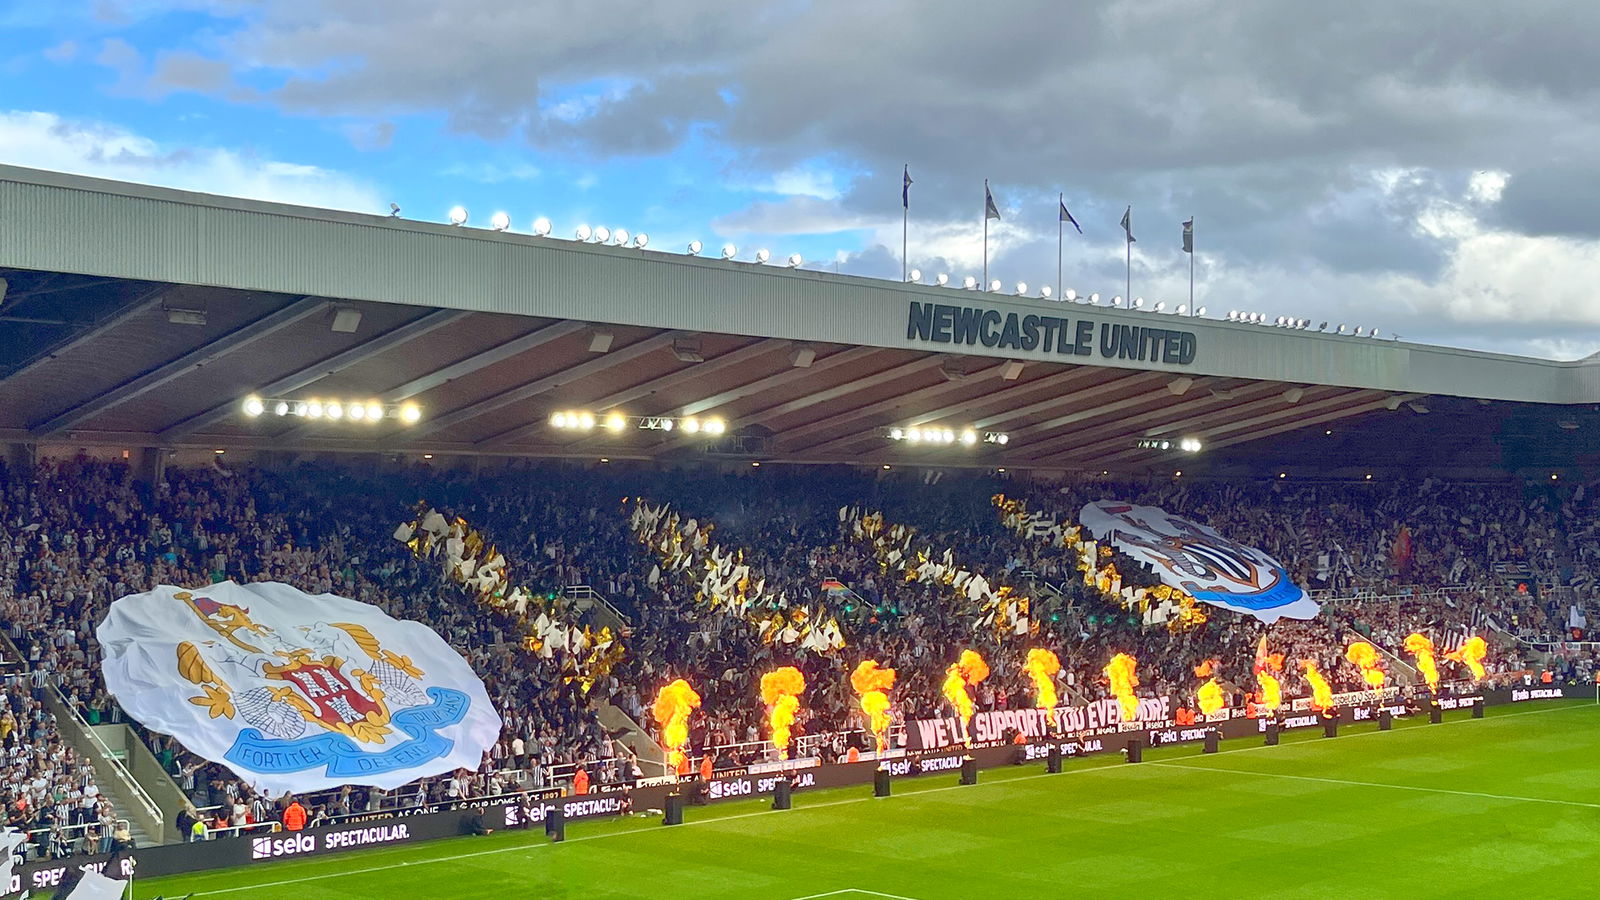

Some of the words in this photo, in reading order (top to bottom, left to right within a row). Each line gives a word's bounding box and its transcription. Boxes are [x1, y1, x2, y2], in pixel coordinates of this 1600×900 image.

[907, 301, 1094, 356] NEWCASTLE
[1100, 322, 1197, 365] UNITED
[917, 716, 972, 750] WE'LL
[975, 709, 1047, 742] SUPPORT
[1054, 705, 1085, 734] YOU
[242, 747, 322, 768] FORTITER
[1035, 743, 1056, 760] sel
[722, 777, 752, 798] sela
[273, 832, 315, 856] sela
[325, 823, 410, 849] SPECTACULAR.
